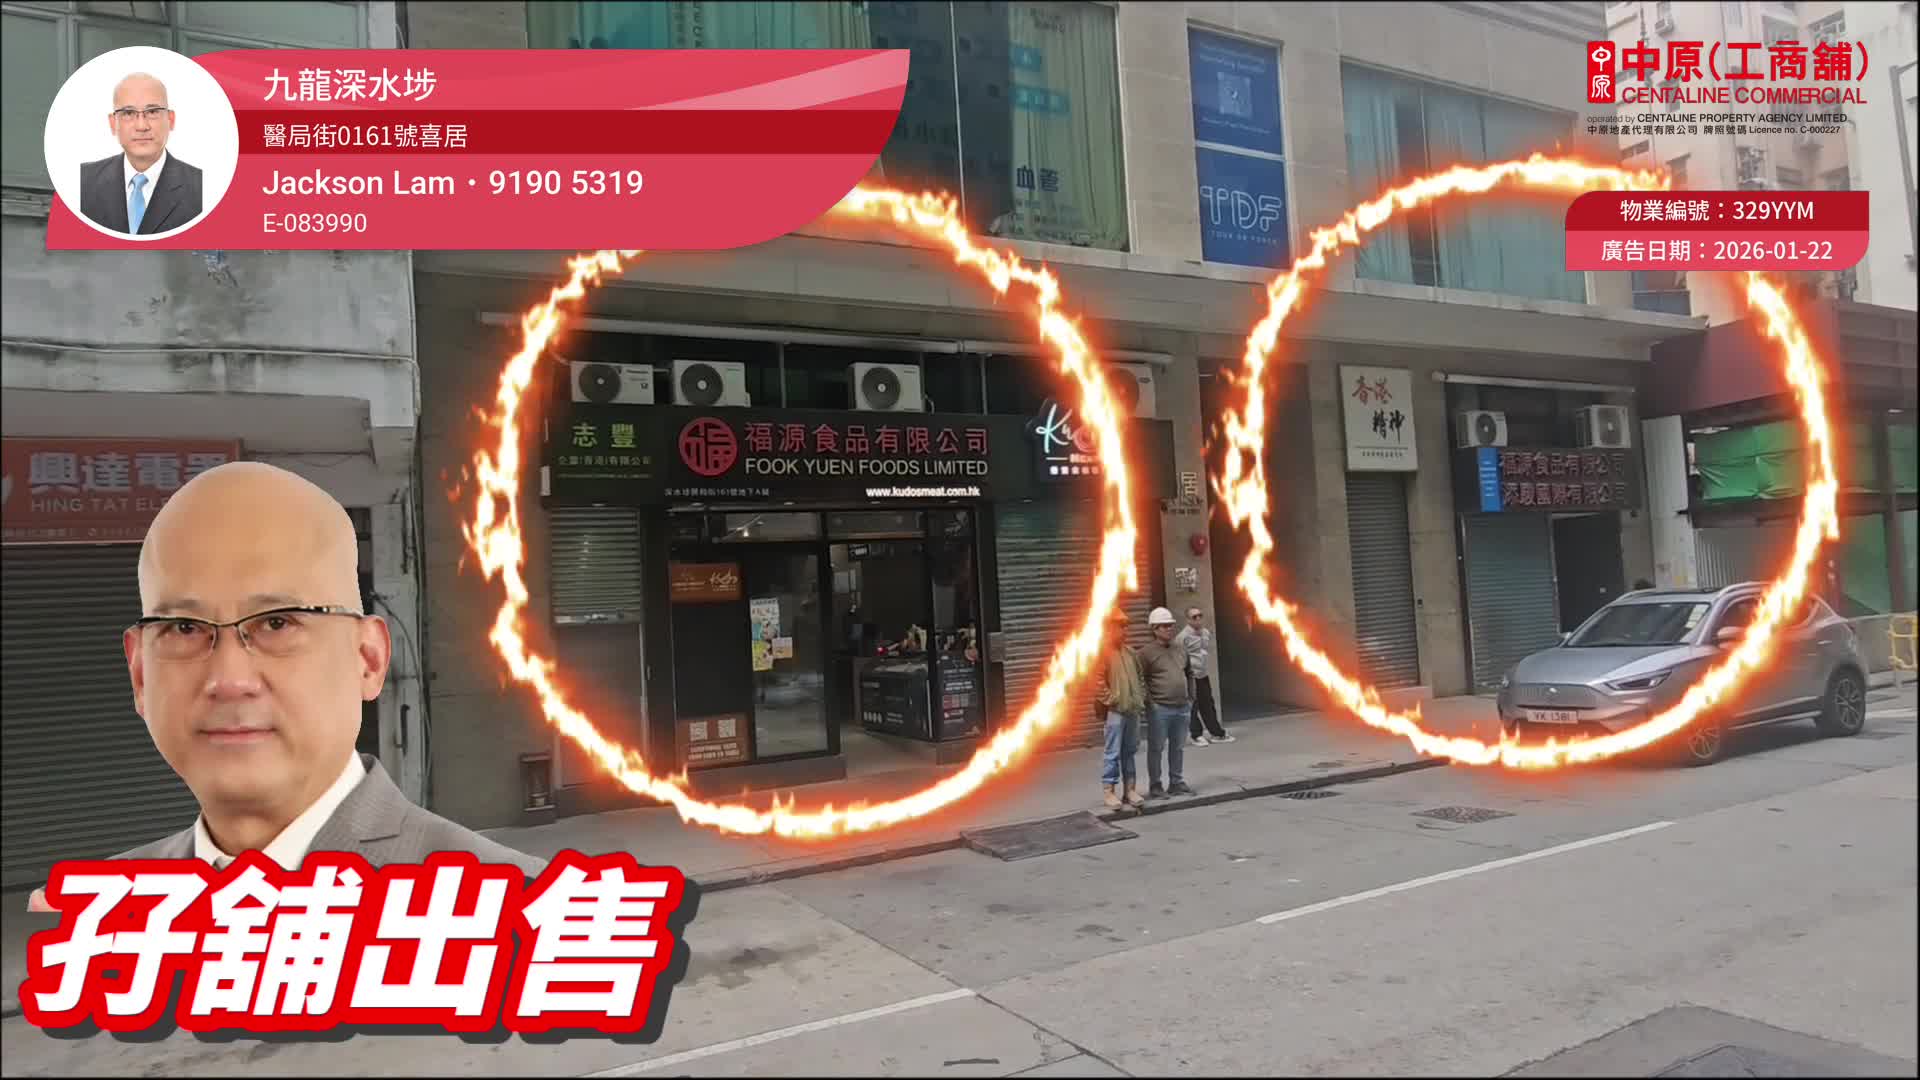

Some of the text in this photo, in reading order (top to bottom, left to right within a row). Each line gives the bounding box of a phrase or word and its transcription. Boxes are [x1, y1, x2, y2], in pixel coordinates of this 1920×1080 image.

[744, 422, 989, 456] 福源食品有限公司
[745, 457, 988, 477] FOOK YUEN FOODS LIMITED
[865, 485, 981, 498] www.kudosmeat.com.hk
[91, 497, 130, 511] TAT
